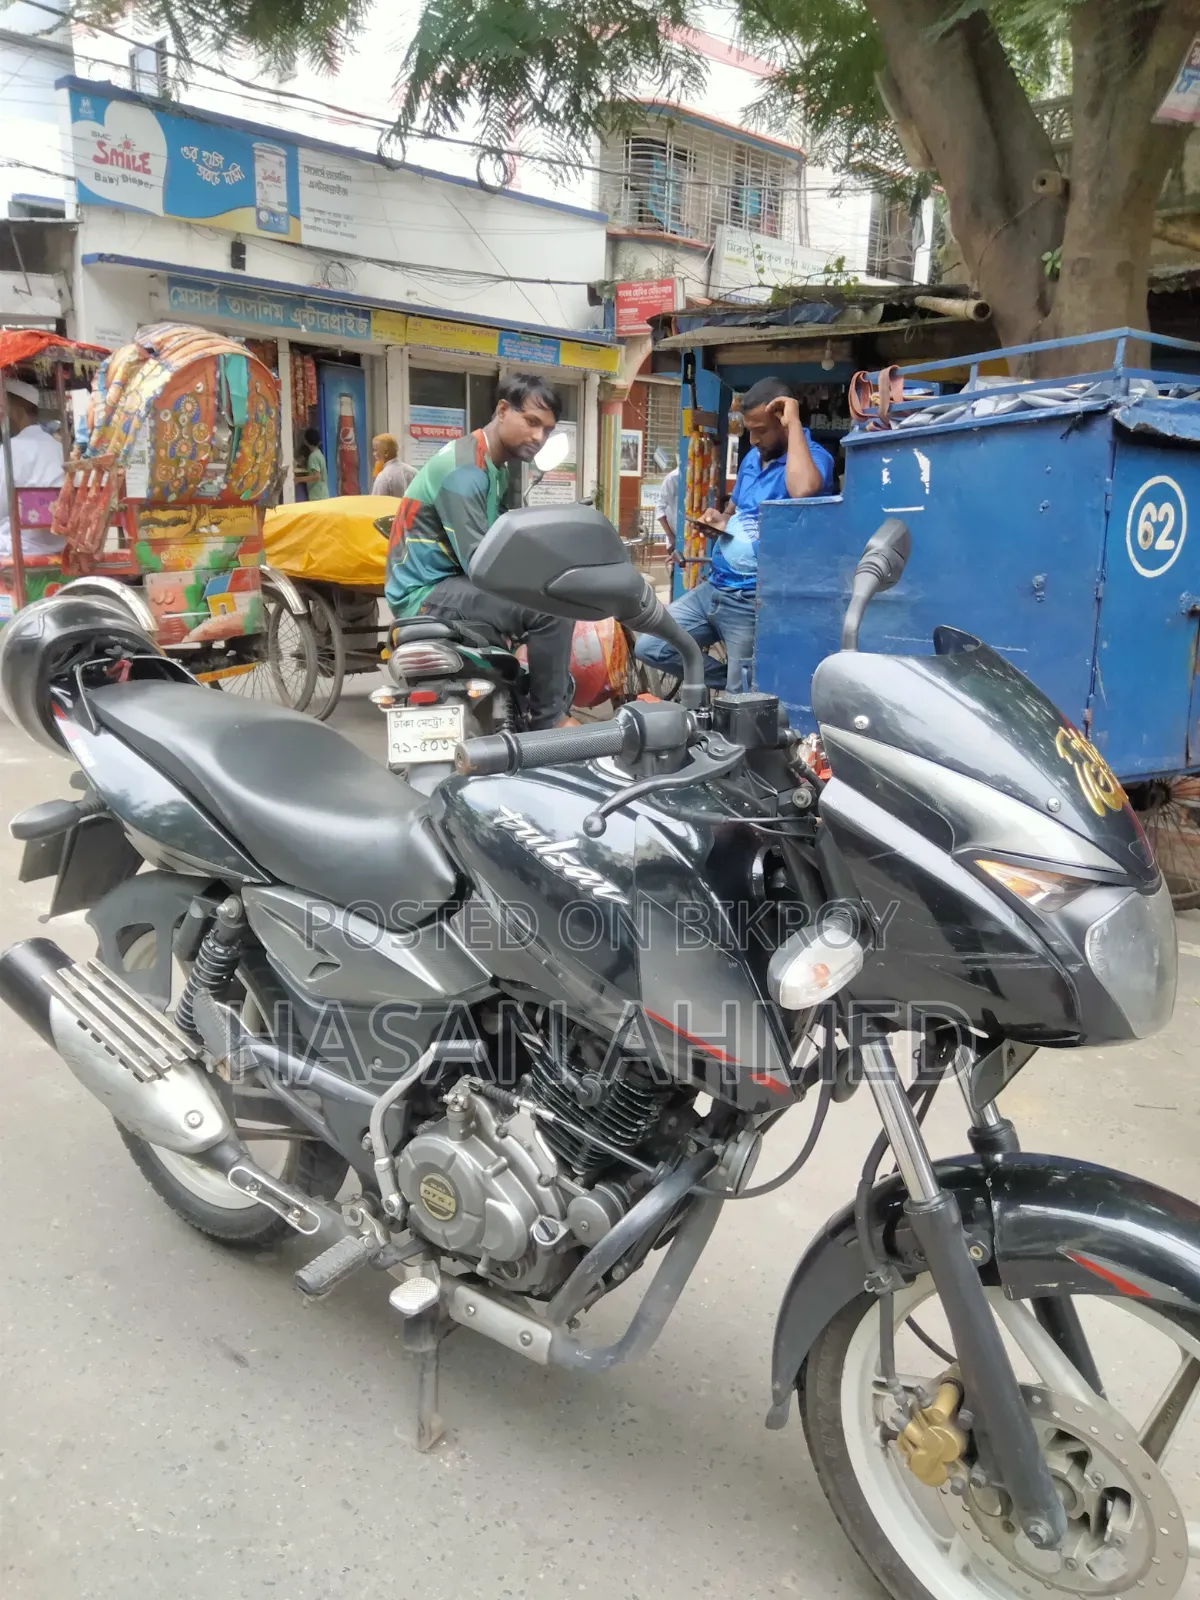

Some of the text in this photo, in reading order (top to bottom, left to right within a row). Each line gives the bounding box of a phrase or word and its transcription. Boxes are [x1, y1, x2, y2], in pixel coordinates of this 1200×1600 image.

[94, 171, 155, 190] Baby Diaper
[170, 284, 220, 312] মেসার্স
[228, 294, 284, 325] তাসনিম
[1137, 502, 1175, 550] 62
